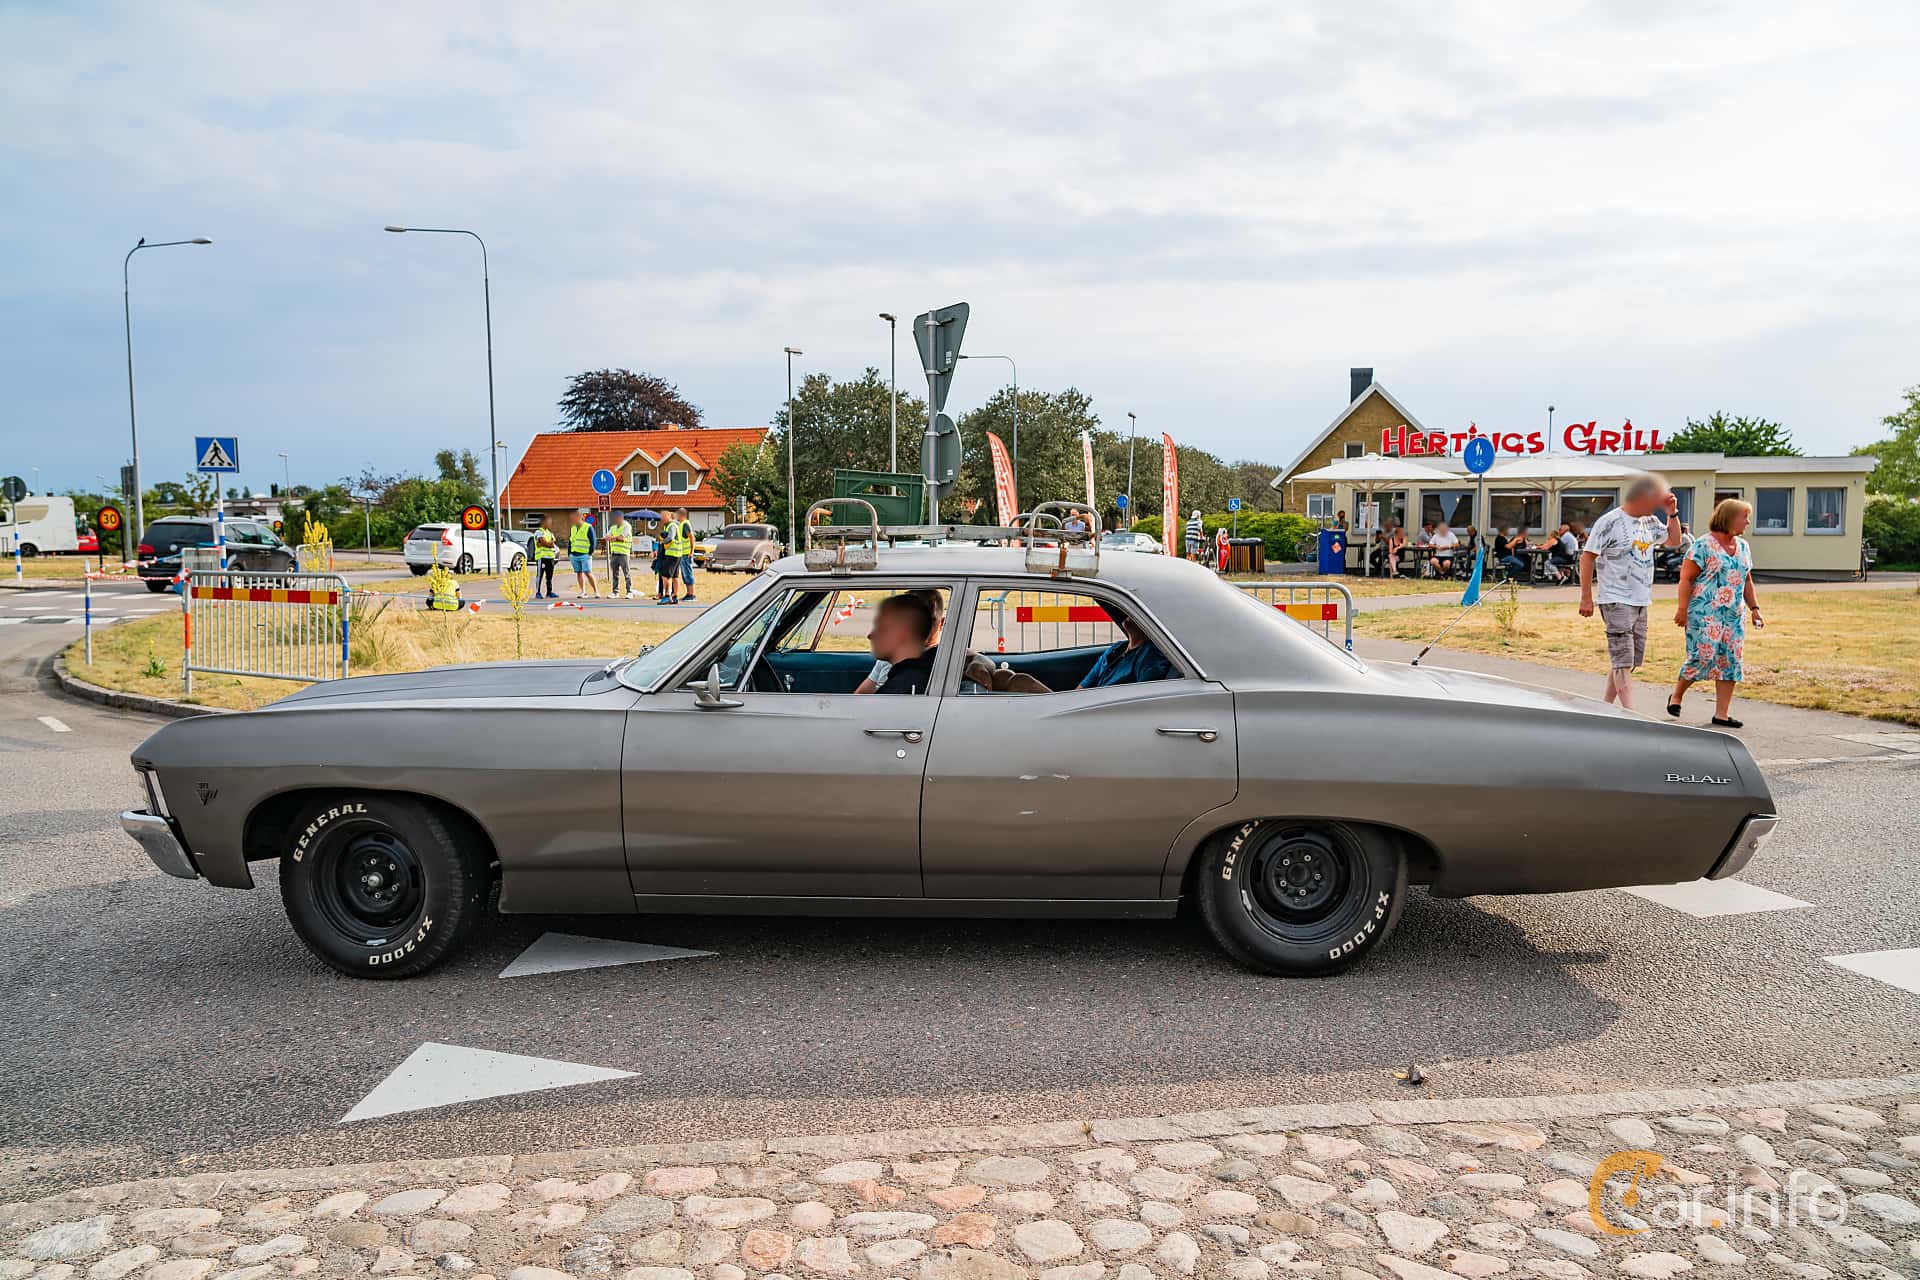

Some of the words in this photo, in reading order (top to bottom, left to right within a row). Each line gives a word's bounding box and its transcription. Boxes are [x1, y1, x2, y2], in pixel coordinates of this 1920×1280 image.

[1563, 420, 1665, 456] GRILL
[103, 513, 117, 525] 30
[467, 513, 482, 524] 30
[293, 803, 368, 864] GENERAL
